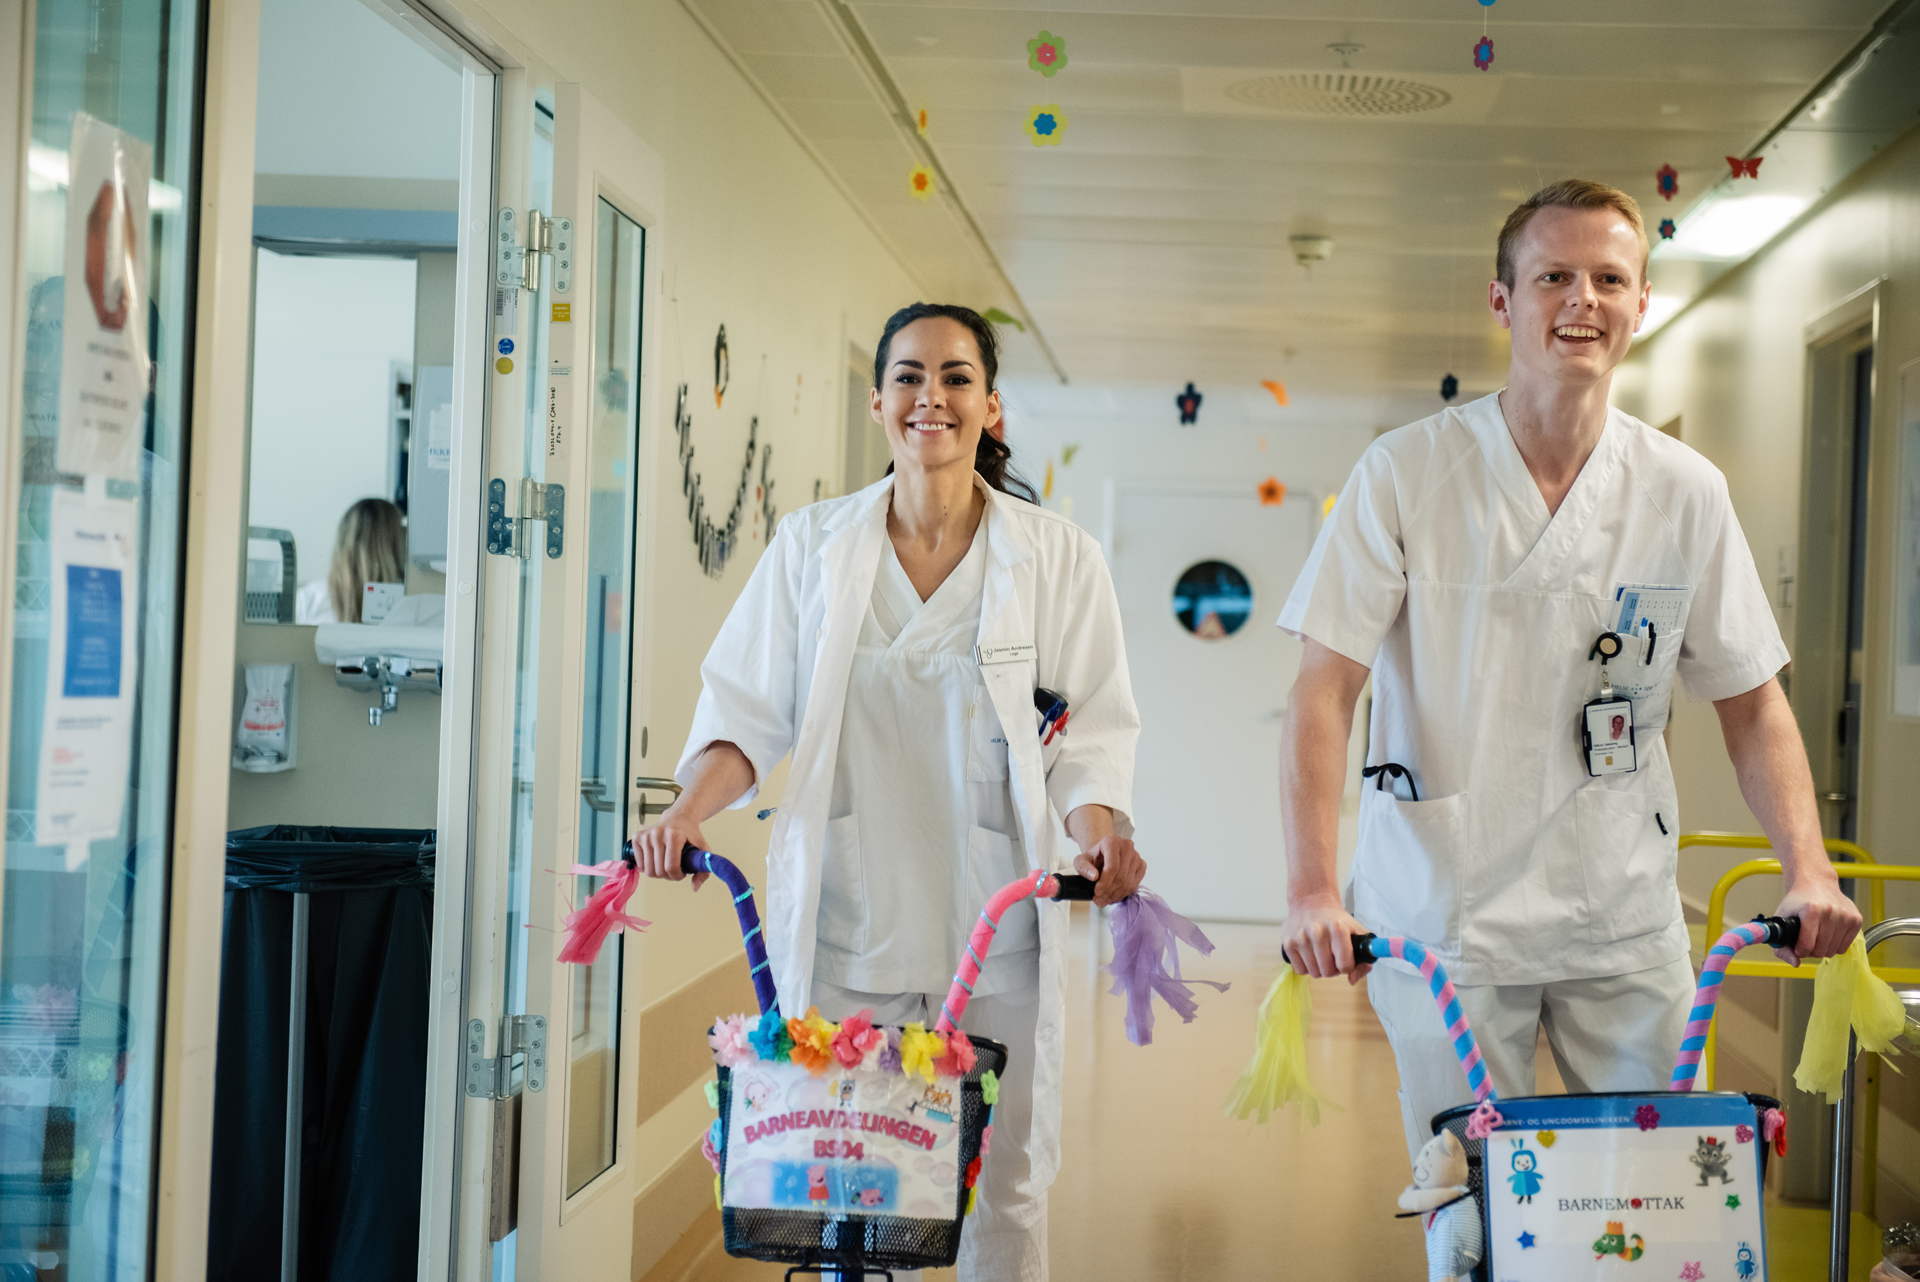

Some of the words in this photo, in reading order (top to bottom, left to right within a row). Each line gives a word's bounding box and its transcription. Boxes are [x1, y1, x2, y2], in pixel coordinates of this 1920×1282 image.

[744, 1109, 937, 1150] BARNEAVDELINGEN
[1527, 1118, 1540, 1126] OG
[1542, 1116, 1631, 1126] UNGDOMSKLINIKKEN
[814, 1139, 864, 1160] BS04
